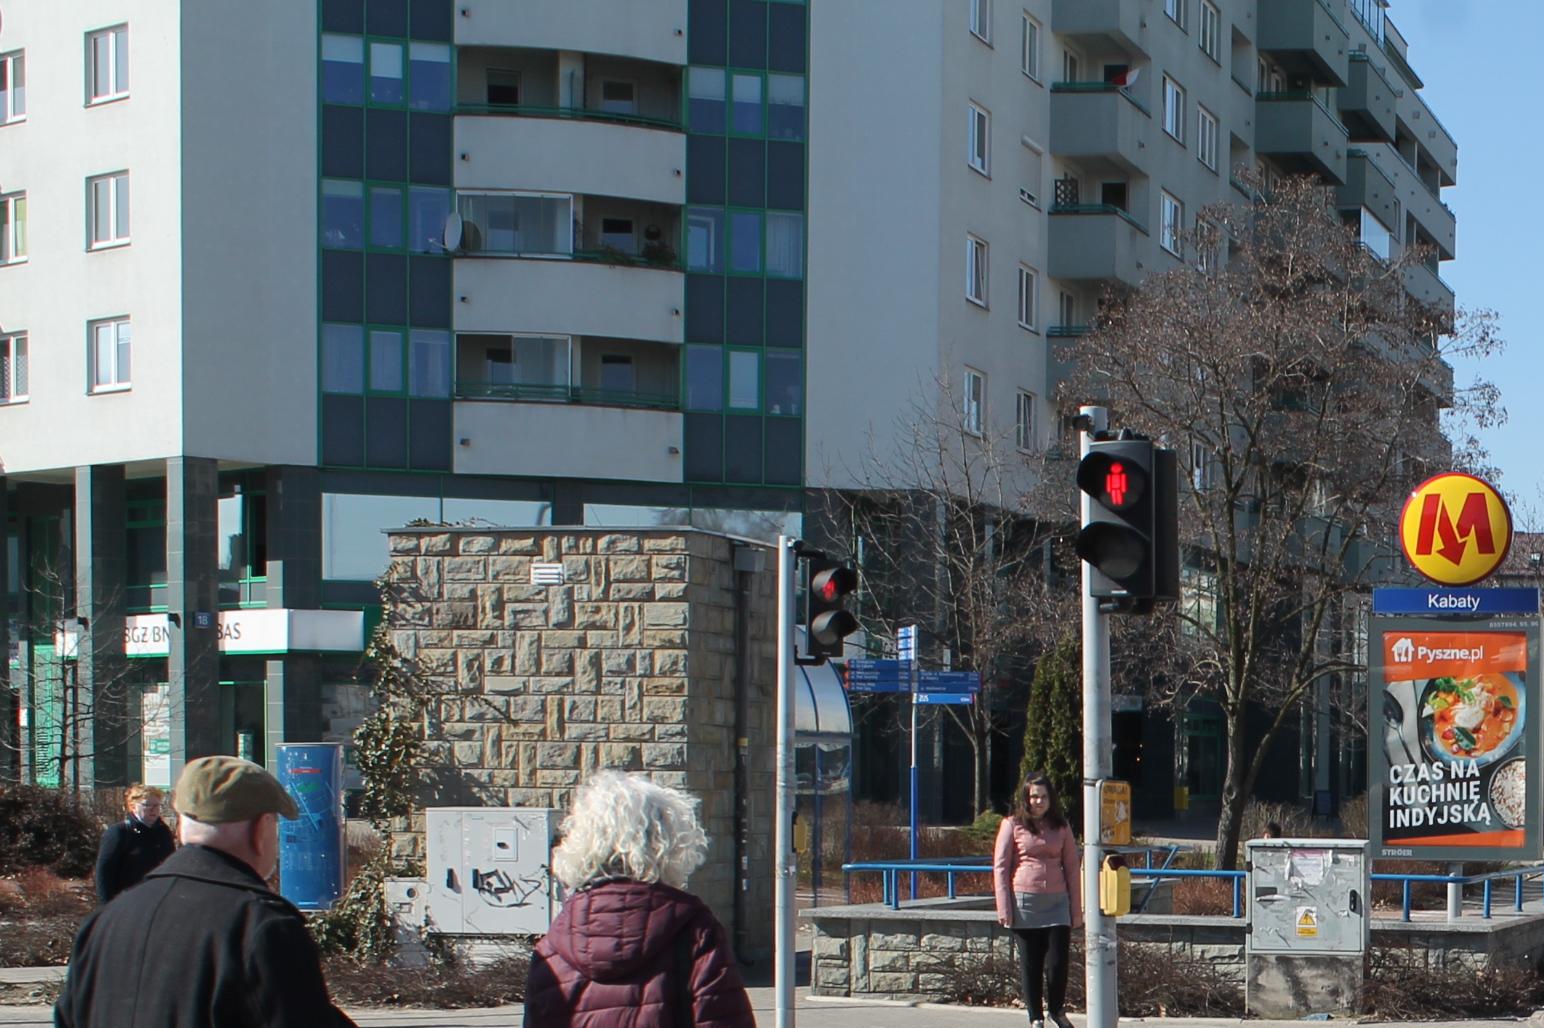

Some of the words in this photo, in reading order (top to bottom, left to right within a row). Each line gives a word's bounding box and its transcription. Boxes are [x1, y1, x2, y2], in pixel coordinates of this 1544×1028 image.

[1428, 593, 1481, 611] Kabaty
[197, 615, 209, 626] 18
[152, 625, 170, 643] BN
[1417, 645, 1484, 663] Pyszne.pl
[1389, 761, 1444, 784] CZAS
[1450, 759, 1480, 780] NA
[1389, 780, 1481, 806] KUCHNIĘ
[1389, 802, 1492, 829] INDYJSKĄ
